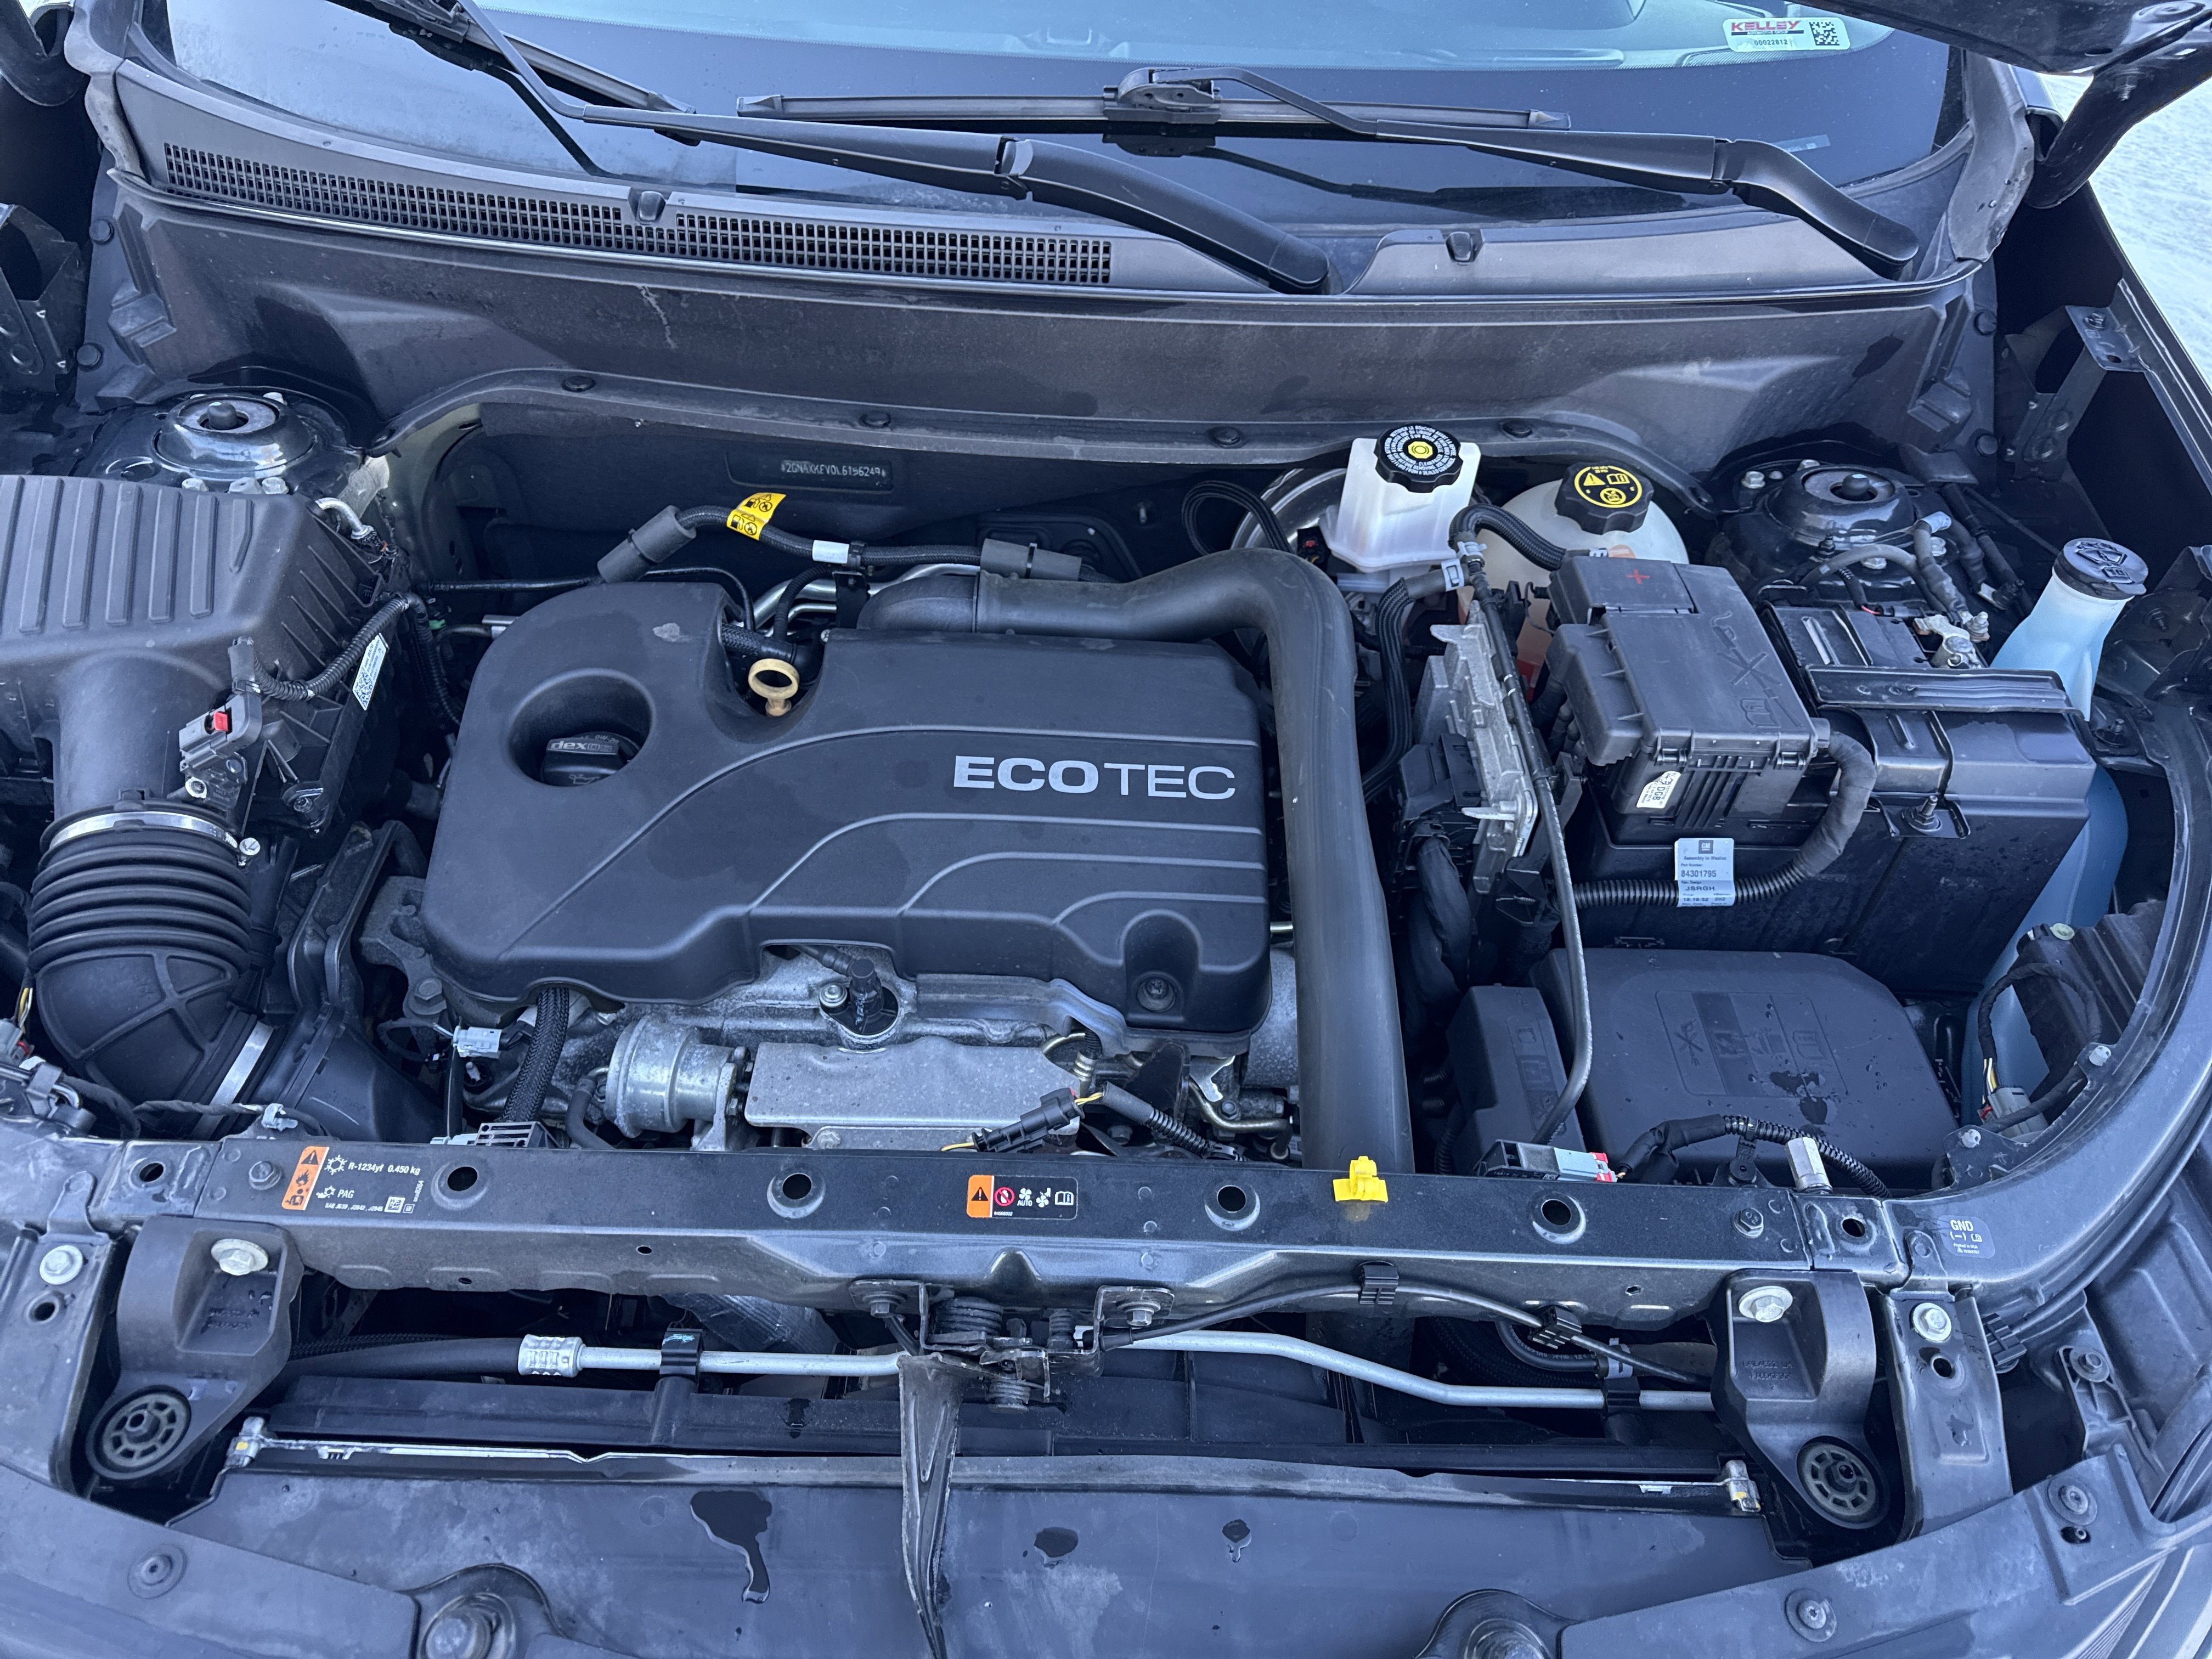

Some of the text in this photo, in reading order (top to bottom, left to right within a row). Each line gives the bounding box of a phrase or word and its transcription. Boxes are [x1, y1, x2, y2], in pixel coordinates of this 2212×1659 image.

[1731, 20, 1801, 31] KELLEY
[953, 755, 1235, 799] ECOTEC
[1652, 787, 1666, 800] DGB
[348, 1164, 421, 1176] R-1234yf 0.450 kg
[337, 1190, 355, 1199] PAG
[1950, 1220, 1974, 1232] GND
